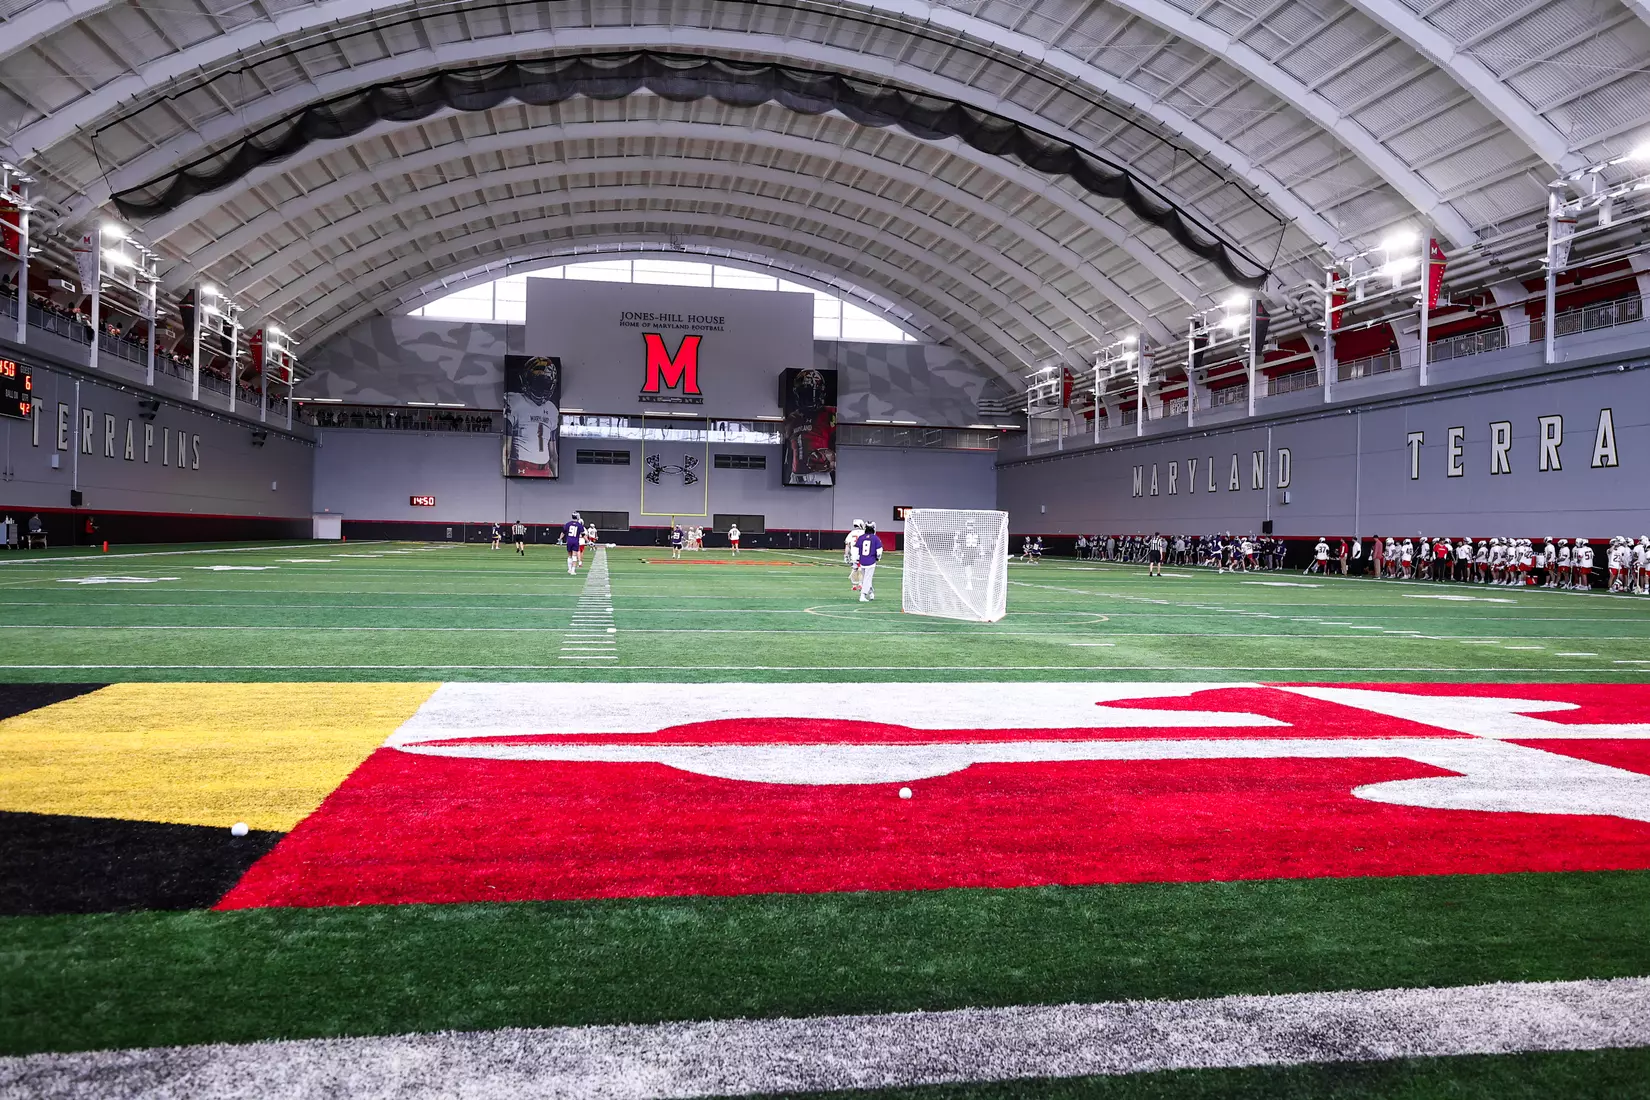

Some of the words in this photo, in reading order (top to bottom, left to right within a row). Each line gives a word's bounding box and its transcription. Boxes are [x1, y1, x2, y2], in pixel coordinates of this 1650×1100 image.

[1431, 247, 1438, 255] M
[620, 311, 684, 322] JONES-HILL
[688, 315, 725, 325] HOUSE
[640, 332, 703, 396] M
[25, 375, 31, 390] 6
[31, 396, 200, 470] TERRAPINS
[1407, 408, 1620, 480] TERRA
[1132, 448, 1292, 498] MARYLAND
[568, 525, 578, 537] 91
[862, 540, 872, 556] 8
[1318, 546, 1327, 554] 37
